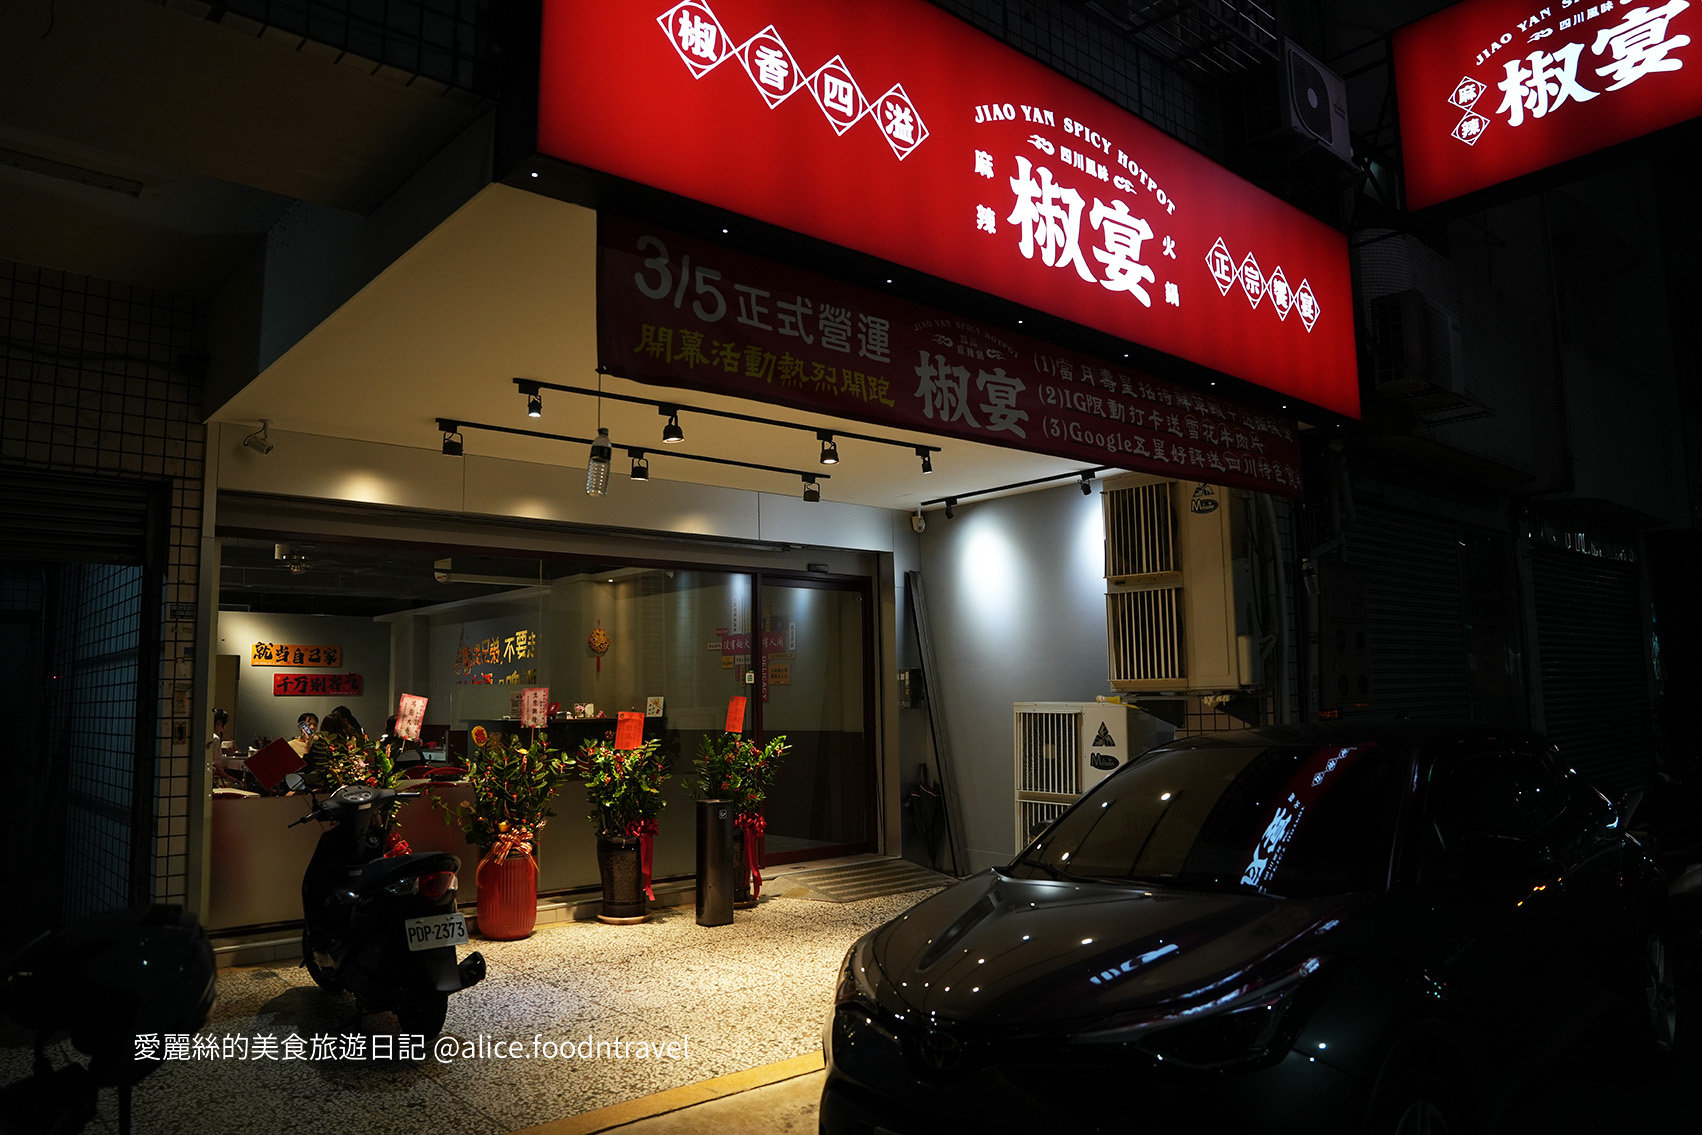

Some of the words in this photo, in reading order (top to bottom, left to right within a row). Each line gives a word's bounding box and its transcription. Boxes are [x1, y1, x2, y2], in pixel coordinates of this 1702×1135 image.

[677, 10, 915, 146] 椒香四溢
[1476, 32, 1513, 66] JIAO
[1517, 7, 1552, 32] YAN
[1495, 0, 1691, 127] 椒宴
[1457, 83, 1482, 139] 麻辣
[974, 103, 1016, 124] JIAO
[1020, 105, 1056, 128] YAN
[1063, 117, 1112, 155] SPICY
[1117, 149, 1176, 216] HOTPOT
[974, 150, 996, 234] 麻辣
[1006, 155, 1156, 308] 椒宴
[1162, 235, 1180, 307] 火鍋
[634, 235, 727, 323] 3/5
[733, 283, 891, 364] 正式營運
[913, 320, 933, 332] JIAO
[934, 319, 952, 328] YAN
[955, 321, 981, 336] SPICY
[984, 332, 1020, 359] HOTPOT
[633, 323, 896, 408] 開幕活動熱烈開跑
[913, 349, 1029, 440] 椒宴
[408, 922, 464, 943] PDP-2373
